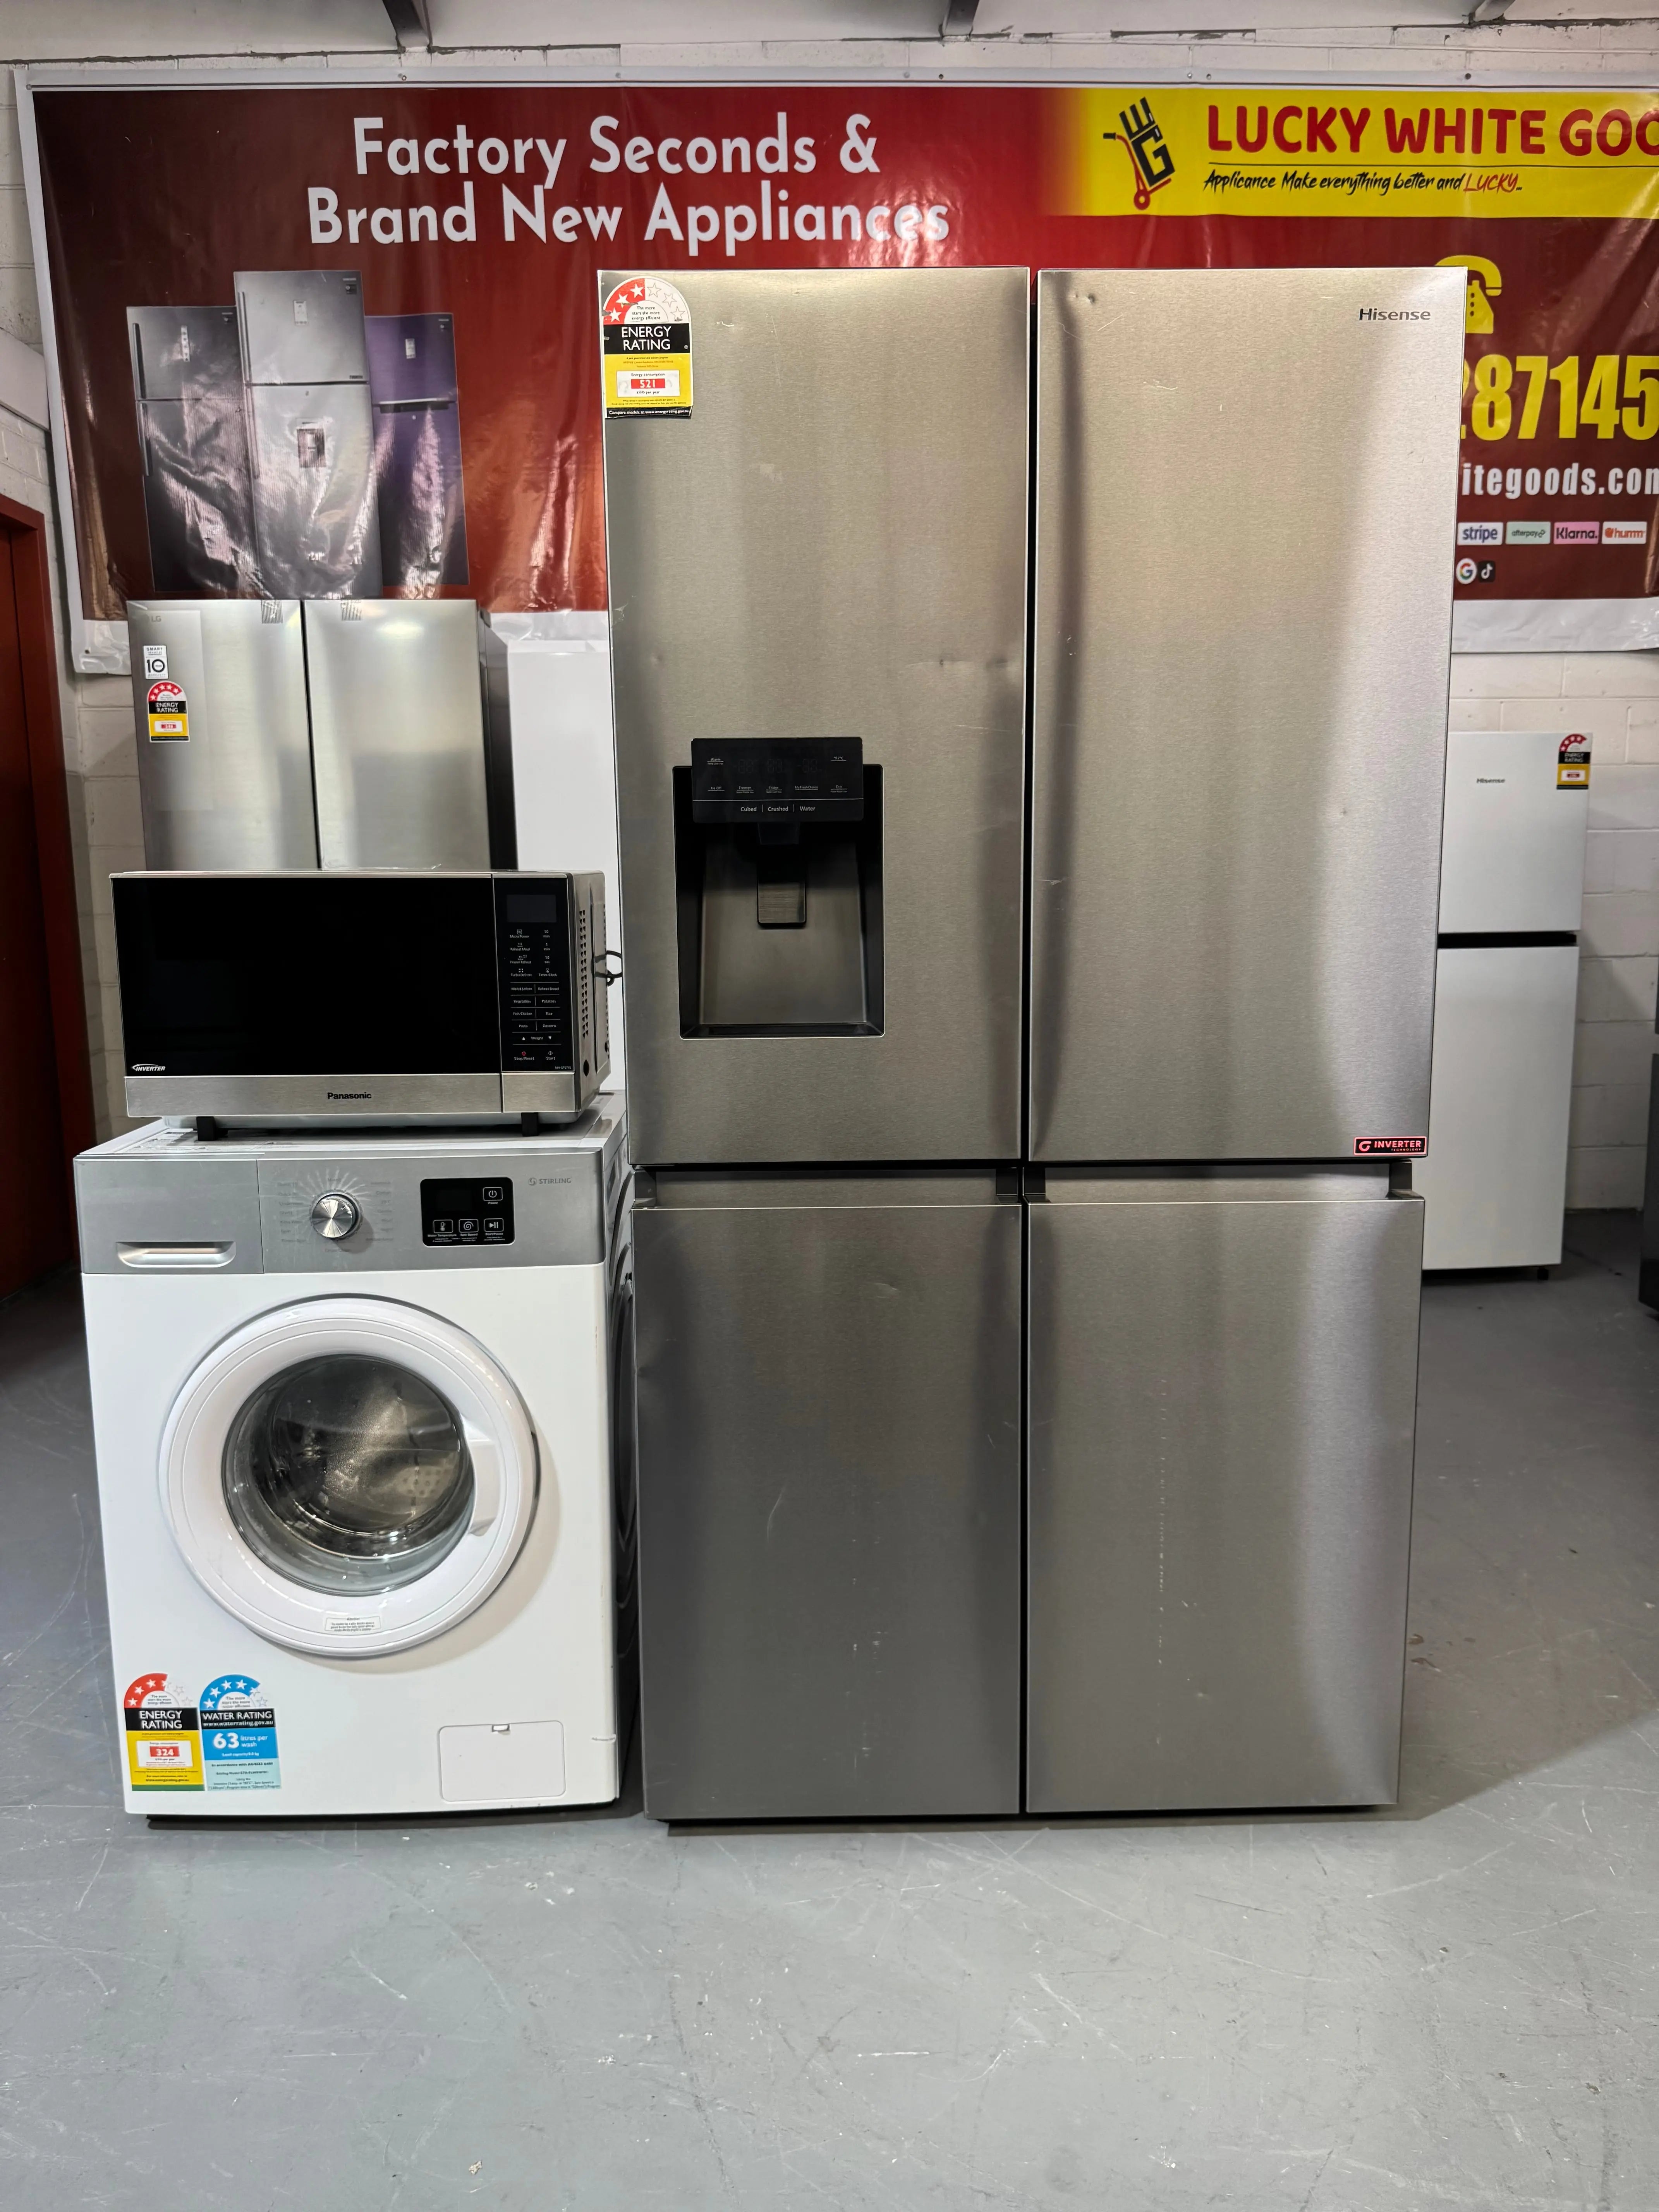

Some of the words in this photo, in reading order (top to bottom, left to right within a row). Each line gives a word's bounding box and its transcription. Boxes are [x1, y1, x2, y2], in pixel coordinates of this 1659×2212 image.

[1209, 105, 1370, 153] LUCKY
[1384, 108, 1546, 154] WHITE
[354, 117, 567, 189] Factory
[589, 112, 816, 173] Seconds
[840, 114, 880, 173] &
[1203, 169, 1276, 195] Applicance
[1281, 170, 1317, 191] Make
[1319, 171, 1391, 196] everything
[1393, 172, 1434, 190] better
[1436, 173, 1467, 190] and
[308, 182, 476, 244] Brand
[503, 184, 623, 244] New
[644, 180, 948, 257] Appliances
[1359, 308, 1431, 321] Hisense
[621, 326, 672, 338] ENERGY
[623, 339, 671, 351] RATING
[640, 379, 655, 388] 521
[1462, 526, 1498, 543] stripe
[1511, 529, 1538, 538] afterpay
[1556, 527, 1598, 539] Klarna.
[147, 659, 165, 673] 10
[139, 1710, 182, 1719] ENERGY
[237, 1711, 272, 1719] RATING
[142, 1719, 182, 1729] RATING
[213, 1732, 239, 1749] 63
